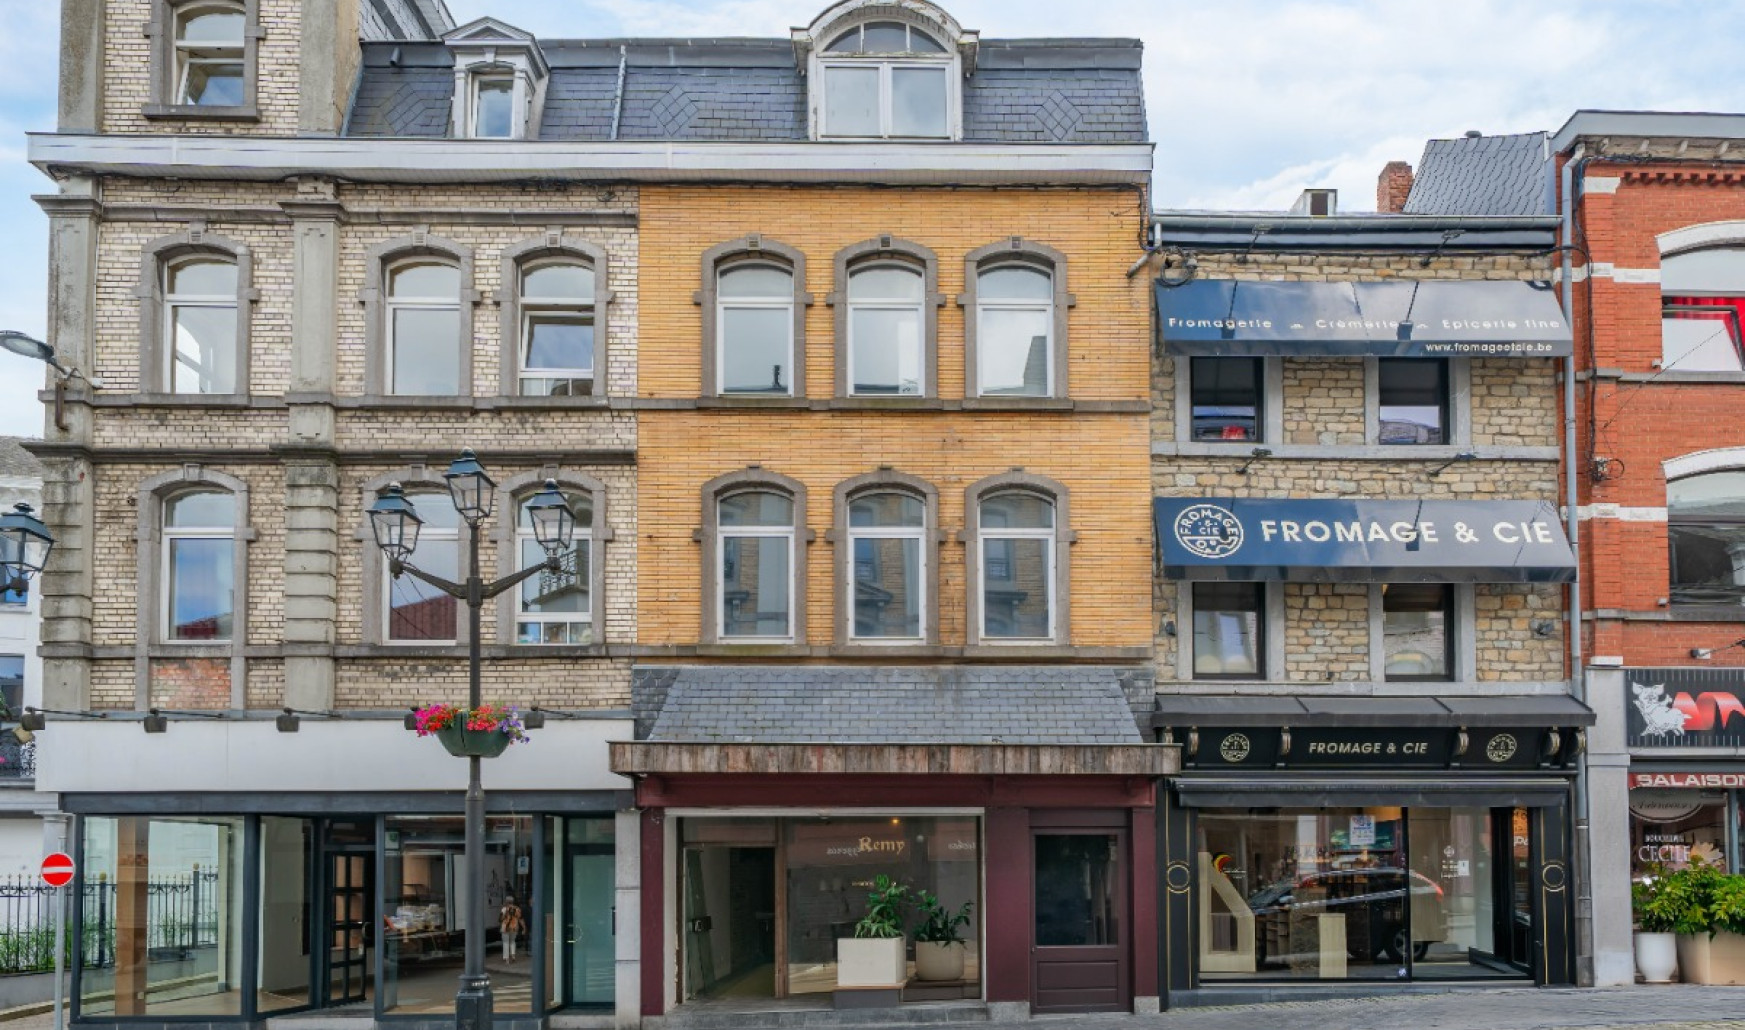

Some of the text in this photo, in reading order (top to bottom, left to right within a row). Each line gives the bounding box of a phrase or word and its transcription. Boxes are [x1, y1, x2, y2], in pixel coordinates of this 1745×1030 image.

[1168, 317, 1272, 330] Fromagerie
[1180, 509, 1239, 535] FROMAGE
[1199, 527, 1220, 535] CIE
[1260, 520, 1553, 543] FROMAGE & CIE
[1308, 742, 1429, 754] FROMAGE & CIE
[859, 836, 905, 855] Remy
